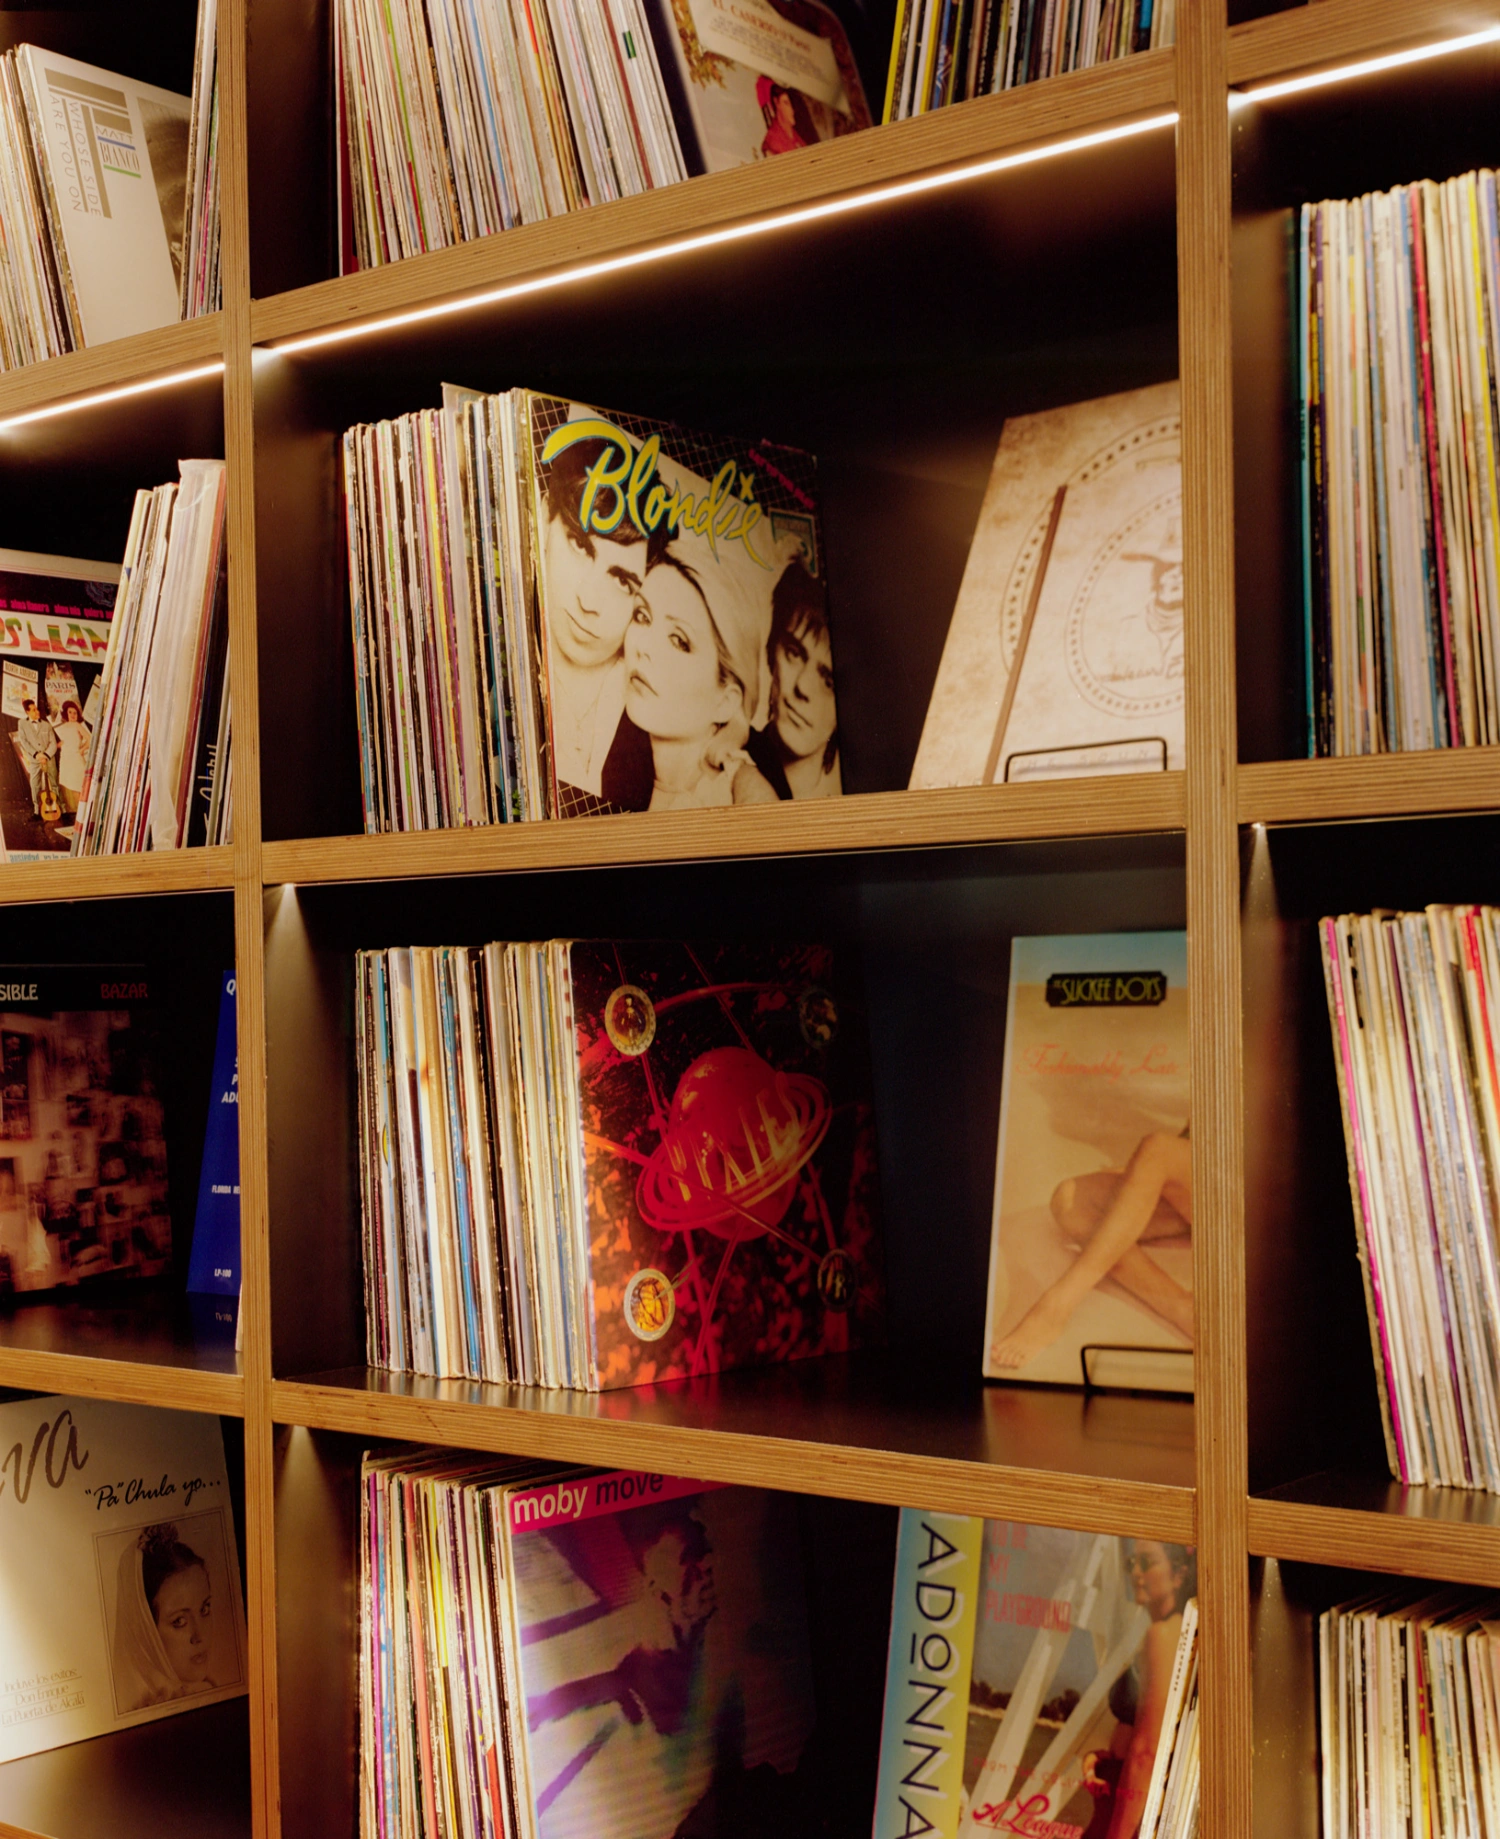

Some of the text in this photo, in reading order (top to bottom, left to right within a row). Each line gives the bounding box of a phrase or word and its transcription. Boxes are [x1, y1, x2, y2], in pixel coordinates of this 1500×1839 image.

[95, 125, 134, 144] MATT
[50, 94, 83, 212] ARE YOU ON
[69, 101, 102, 216] WHOSE SIDE
[100, 142, 140, 171] BLANCO
[541, 418, 774, 572] Blondie
[46, 682, 76, 690] PARIS
[0, 984, 38, 1001] SIBLE
[100, 983, 148, 999] BAZAR
[1115, 977, 1163, 1001] BOYS
[0, 1410, 89, 1504] va
[125, 1474, 176, 1505] Chula
[513, 1474, 664, 1524] moby move
[988, 1552, 1011, 1584] MY
[985, 1589, 1072, 1633] PLAYGROUND
[895, 1512, 965, 1839] ADONNA
[14, 1706, 43, 1721] Puerta
[45, 1700, 57, 1713] de
[15, 1694, 36, 1706] Don
[1001, 1794, 1085, 1839] League
